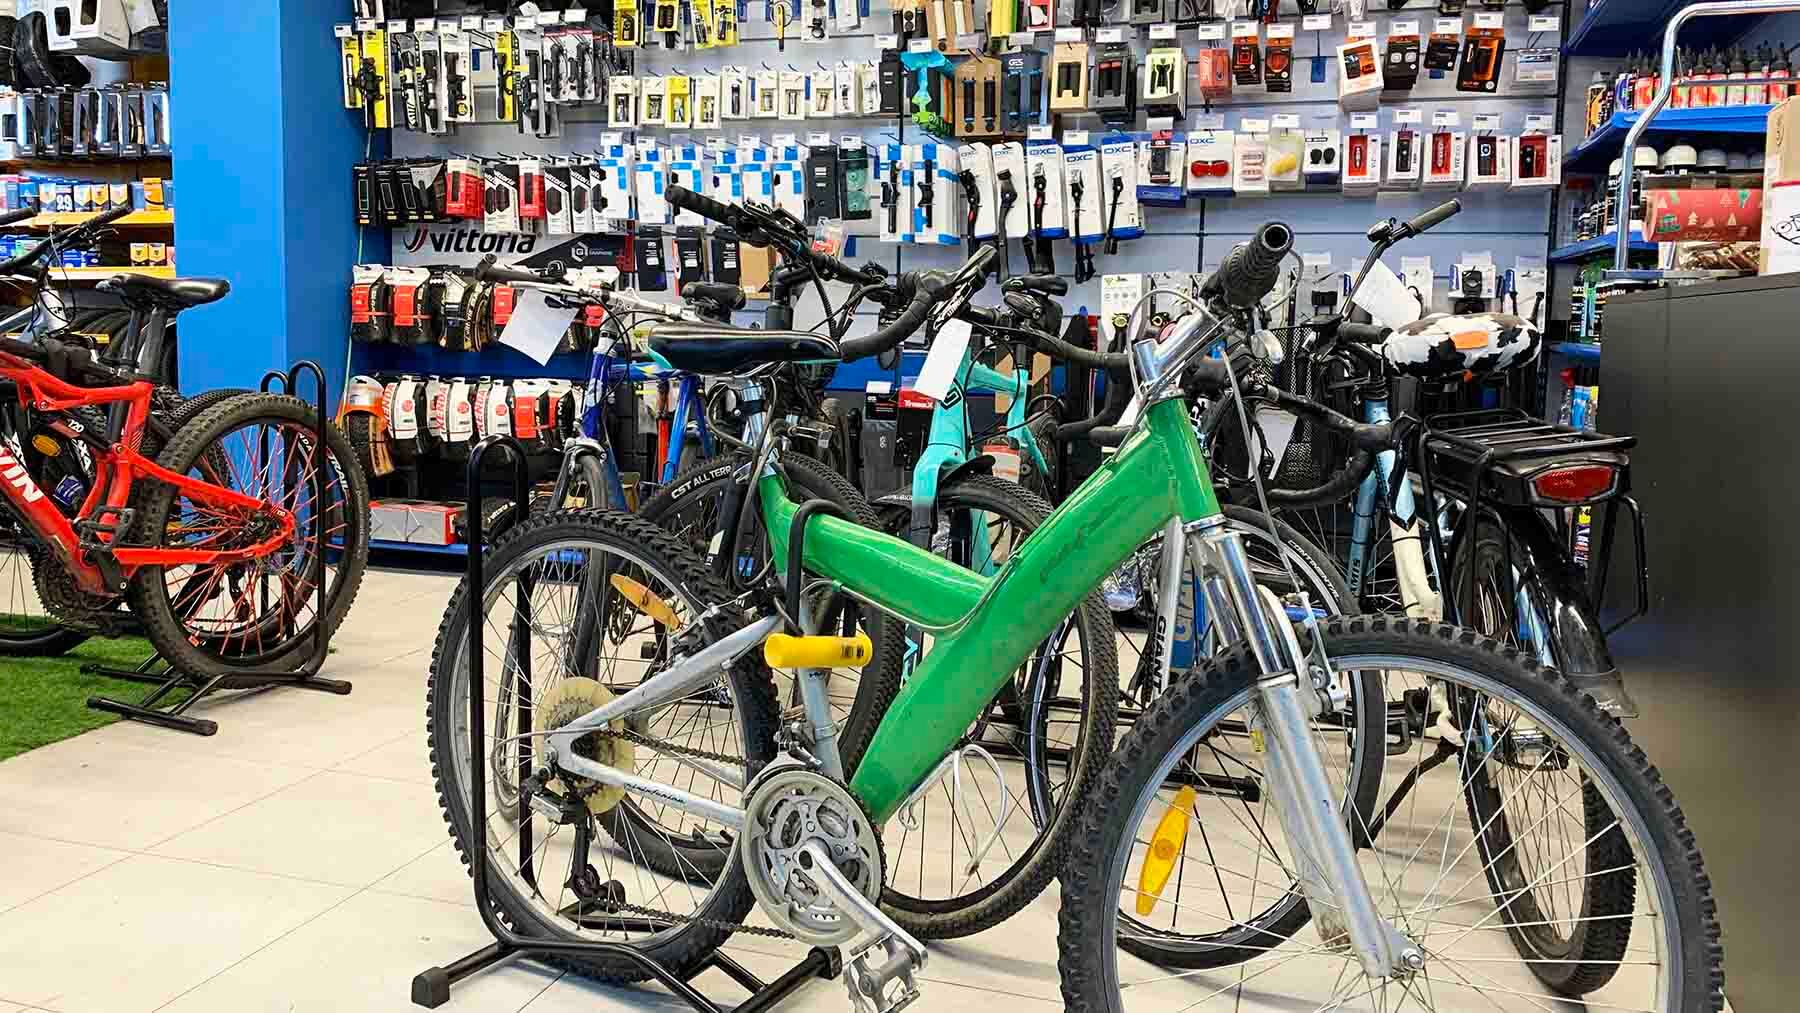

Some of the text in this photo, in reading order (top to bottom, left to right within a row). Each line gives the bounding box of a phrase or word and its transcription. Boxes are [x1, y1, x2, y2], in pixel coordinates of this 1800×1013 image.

[1029, 147, 1057, 156] DXC
[1066, 154, 1093, 162] DXC
[1104, 146, 1132, 155] DXC
[56, 194, 73, 210] 29
[430, 228, 537, 253] vittoria
[436, 387, 448, 430] KENDA
[475, 390, 487, 432] KENDA
[68, 419, 84, 432] 120
[671, 480, 692, 499] CST
[1152, 616, 1166, 694] GIANT
